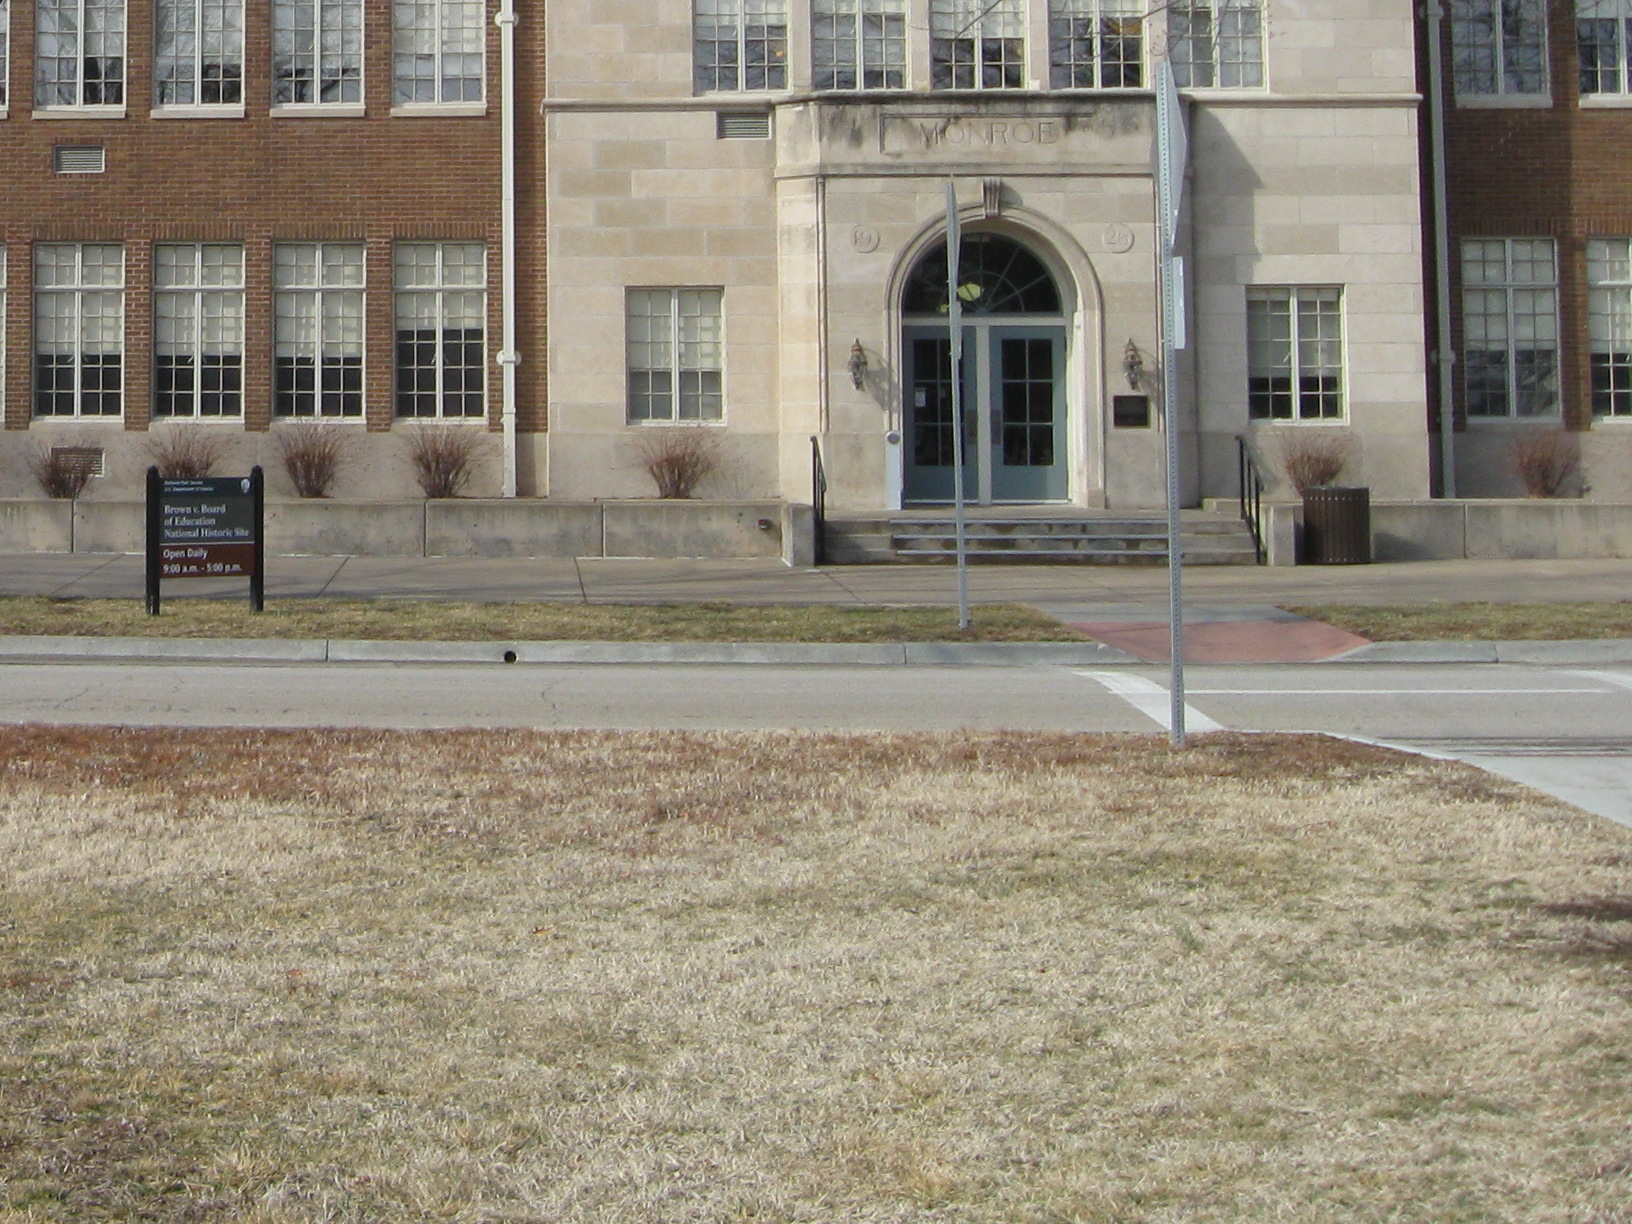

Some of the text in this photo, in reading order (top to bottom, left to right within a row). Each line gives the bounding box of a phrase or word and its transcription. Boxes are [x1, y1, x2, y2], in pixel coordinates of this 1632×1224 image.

[919, 122, 1057, 145] MONROE
[164, 504, 191, 514] Brown
[201, 504, 226, 513] Board
[164, 516, 216, 526] of Education
[164, 527, 249, 538] National Historic Site
[163, 548, 208, 560] Open Daily
[163, 564, 180, 573] 9:00
[207, 563, 223, 572] 5:00
[225, 563, 242, 573] p.m.
